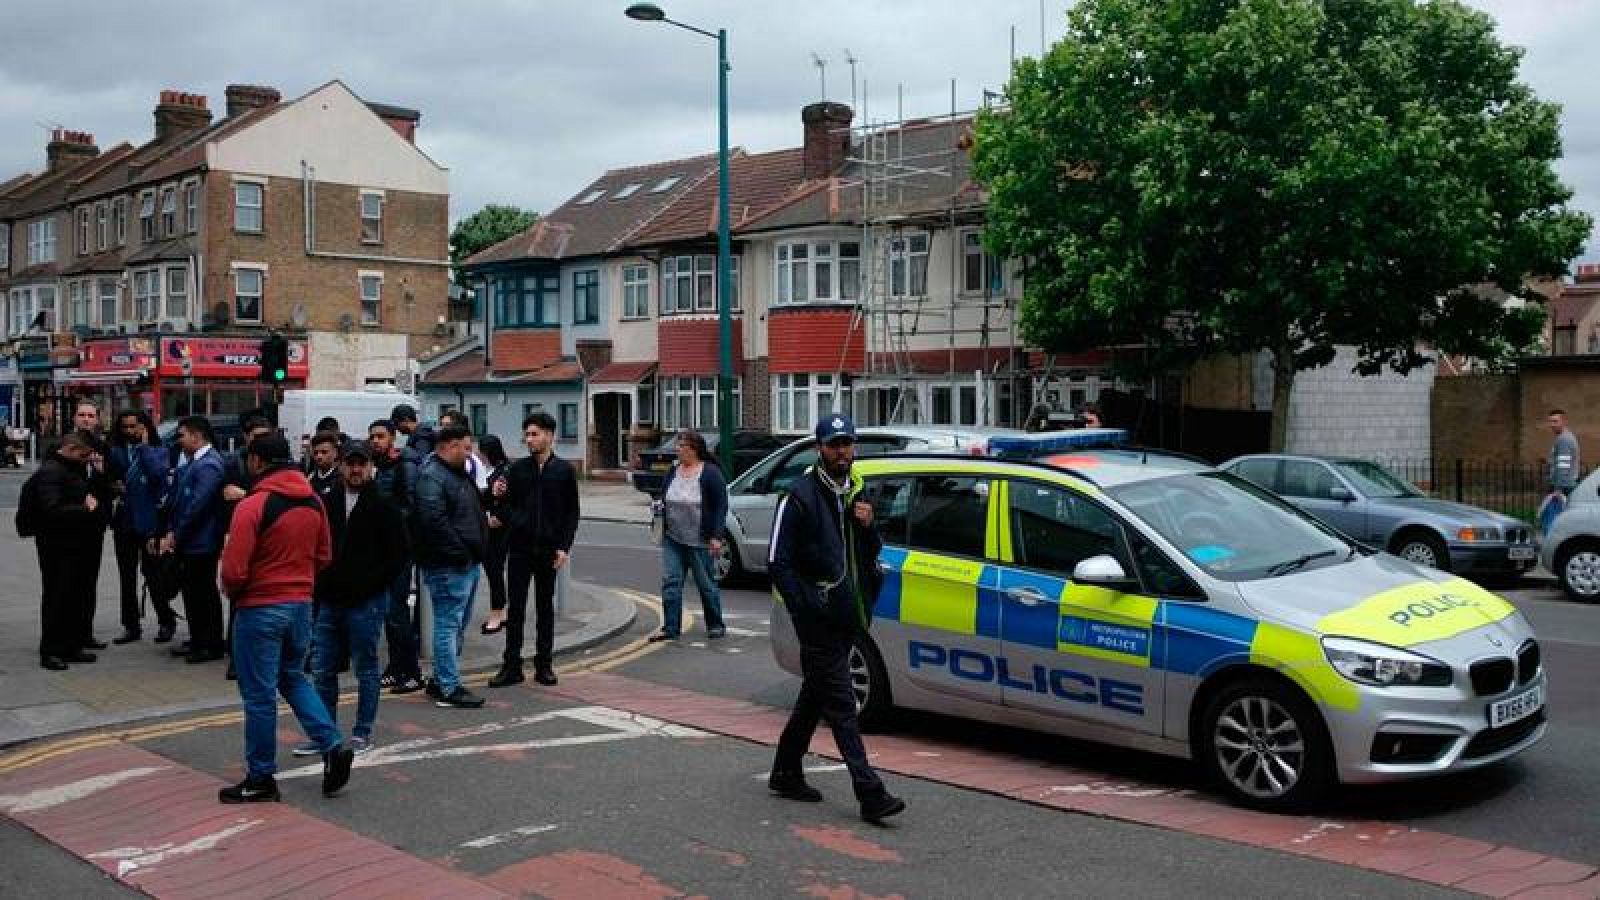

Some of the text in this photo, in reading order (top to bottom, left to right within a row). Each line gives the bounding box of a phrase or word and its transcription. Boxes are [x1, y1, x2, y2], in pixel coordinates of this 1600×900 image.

[225, 354, 259, 365] PIZZ
[1097, 635, 1137, 651] POLICE
[909, 639, 1145, 716] POLICE
